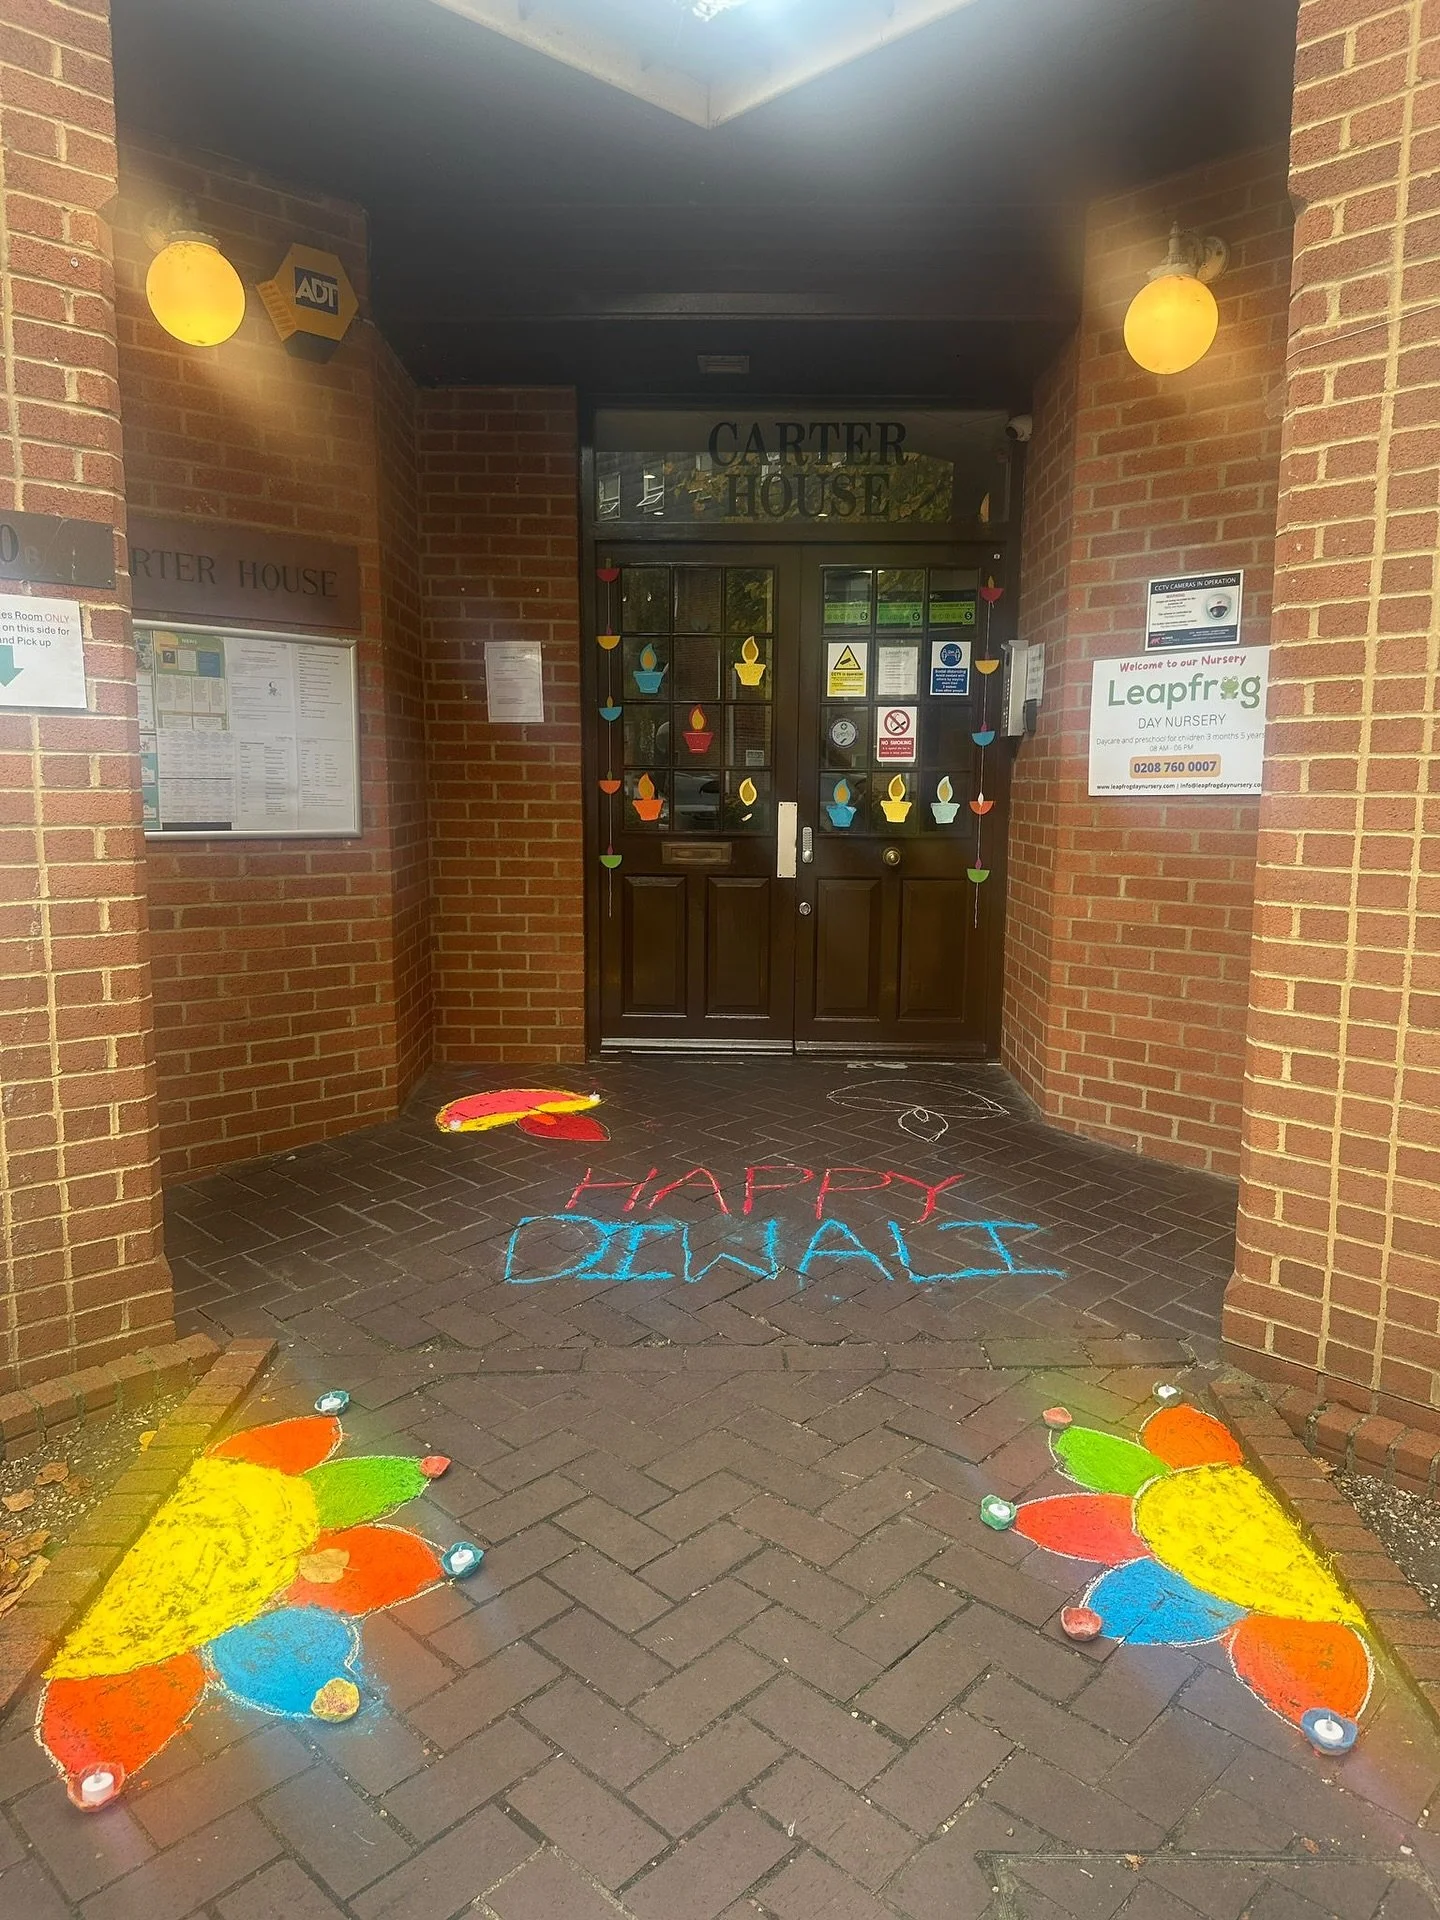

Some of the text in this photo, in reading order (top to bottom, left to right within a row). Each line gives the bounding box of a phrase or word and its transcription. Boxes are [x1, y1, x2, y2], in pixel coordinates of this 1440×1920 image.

[296, 276, 338, 307] ADT
[709, 422, 907, 466] CARTER
[725, 473, 889, 517] HOUSE
[131, 547, 339, 598] RTER HOUSE
[1154, 584, 1170, 592] CCTV
[1170, 581, 1196, 590] CAMERAS
[1204, 577, 1236, 586] OPERATION
[0, 611, 70, 624] es Room ONLY
[17, 625, 35, 633] this
[36, 626, 56, 635] side
[57, 627, 70, 636] for
[17, 636, 38, 646] Pick
[39, 640, 52, 649] up
[1120, 654, 1247, 672] Welcome to our Nursery
[1138, 713, 1226, 730] DAY NURSERY
[1096, 737, 1120, 746] Daycare
[1134, 735, 1167, 745] preschool
[1177, 734, 1205, 742] children
[1133, 761, 1217, 773] 0208 760 0007
[1096, 783, 1175, 791] www.leapfrogdaynursery.com
[1180, 782, 1262, 791] info@leapfrogdaynursery.co
[564, 1165, 966, 1224] HAPPY
[505, 1214, 1069, 1284] DIWALI
